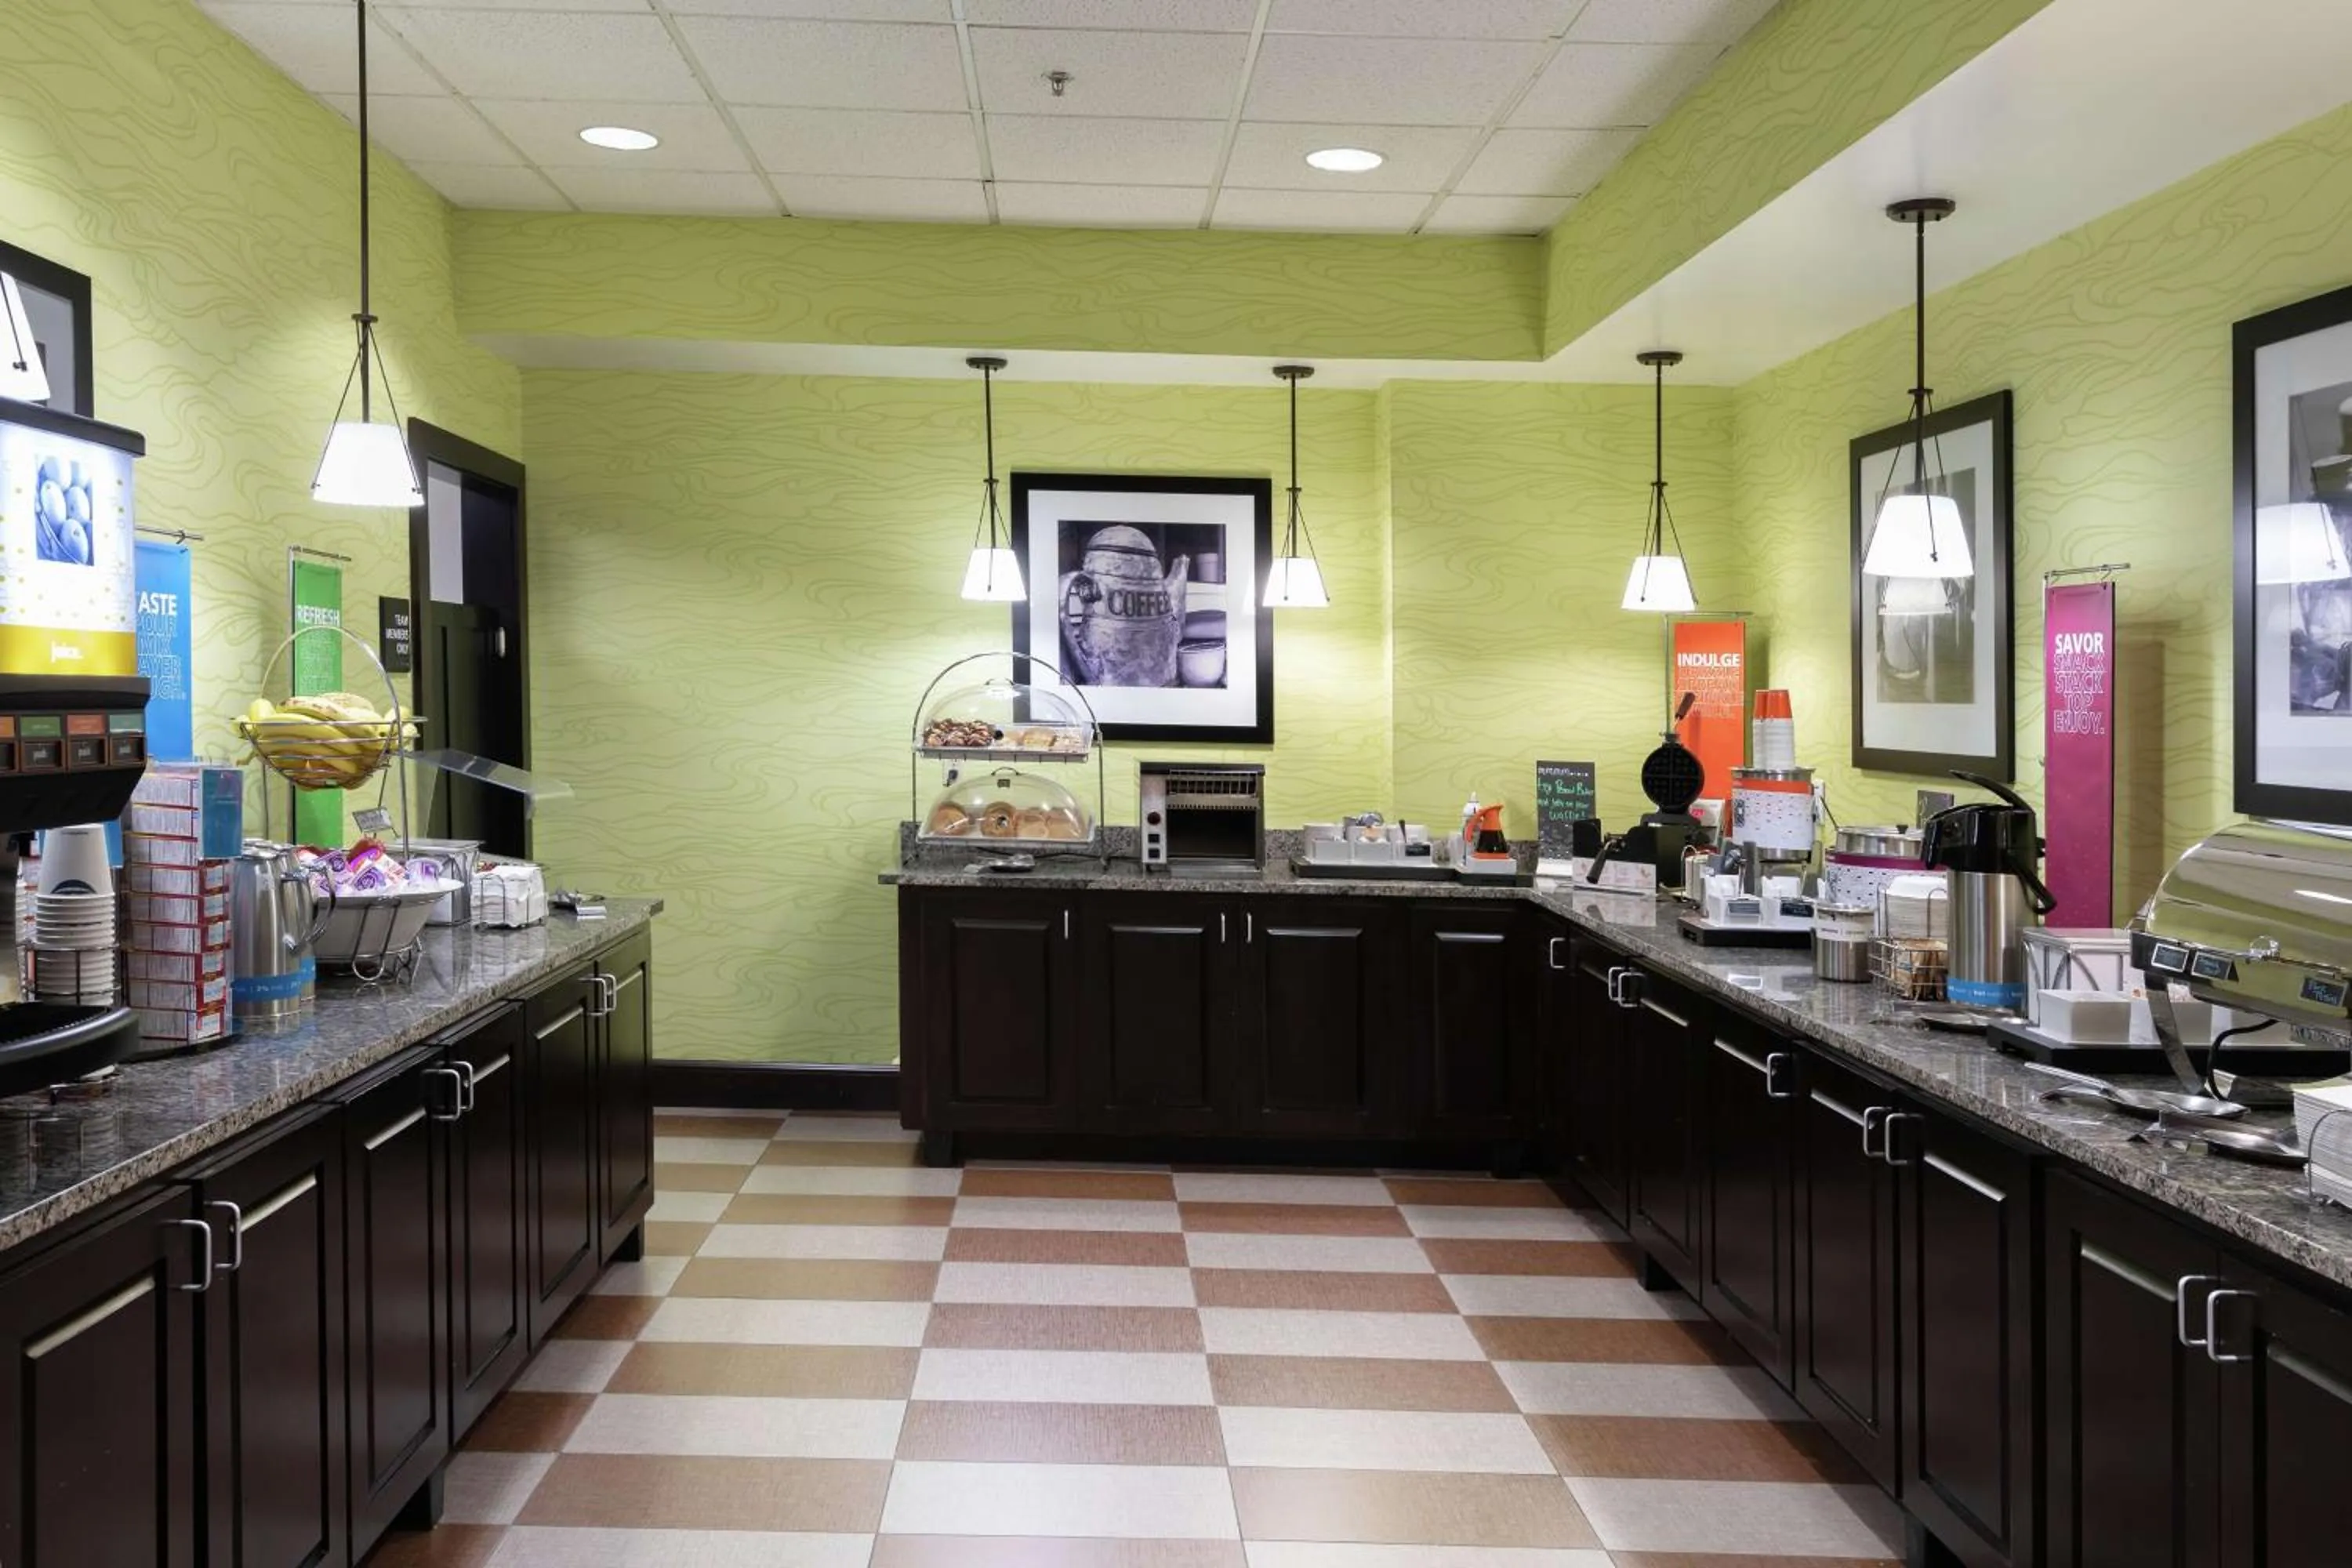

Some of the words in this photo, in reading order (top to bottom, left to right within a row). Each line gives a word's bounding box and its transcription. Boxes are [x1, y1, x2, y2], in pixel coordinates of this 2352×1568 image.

[136, 590, 177, 615] ASTE
[1107, 590, 1173, 617] COFFEE
[296, 604, 340, 626] REFRESH
[2055, 632, 2104, 654] SAVOR
[136, 654, 181, 677] AYER
[1678, 652, 1741, 667] INDULGE
[2054, 670, 2105, 694] STACK
[2053, 709, 2105, 734] ENJOY.
